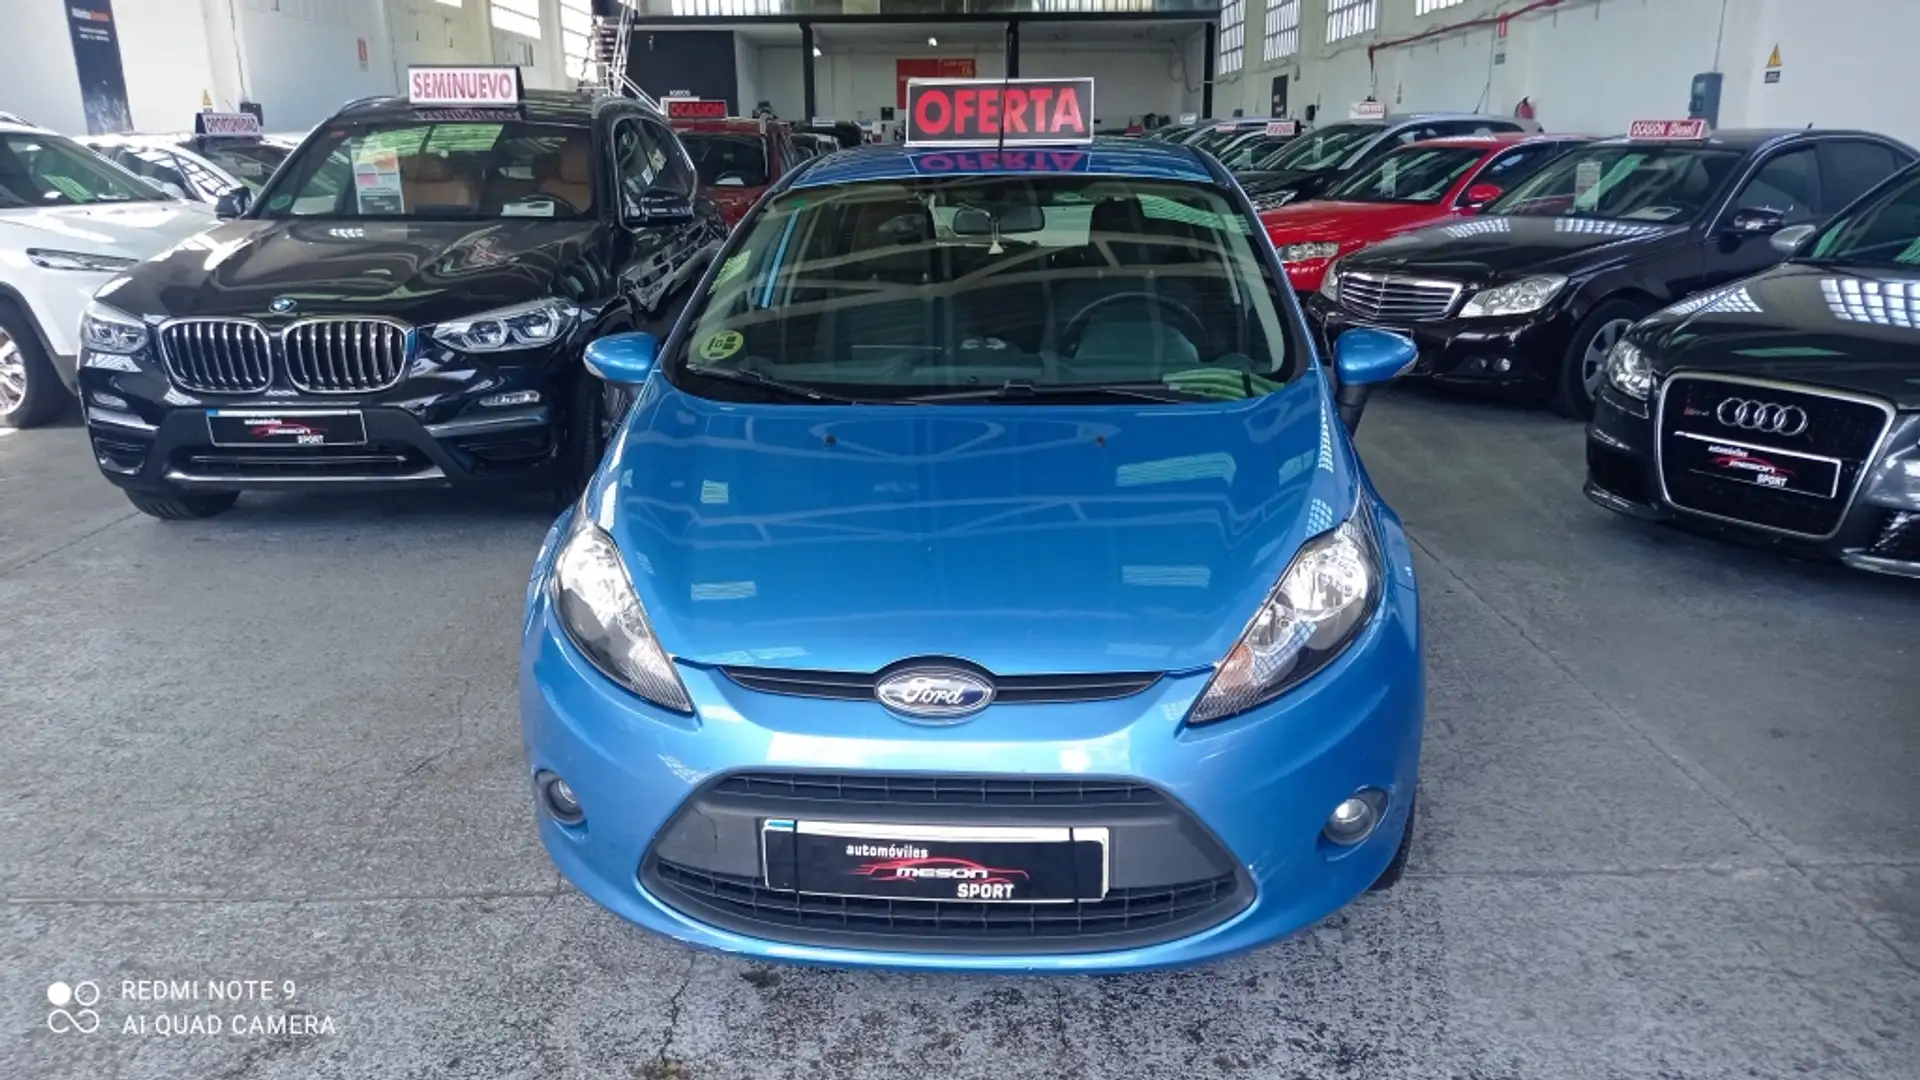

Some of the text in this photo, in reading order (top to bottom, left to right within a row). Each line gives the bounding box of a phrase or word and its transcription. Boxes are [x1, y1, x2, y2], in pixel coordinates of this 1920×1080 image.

[413, 73, 512, 98] SEMINUEVO
[671, 103, 725, 117] OCASION
[915, 88, 1084, 134] OFERTA
[1631, 121, 1667, 137] OCASION
[297, 434, 324, 444] SPORT
[1756, 473, 1788, 487] SPORT
[902, 677, 965, 705] Ford
[845, 843, 928, 859] automóviles
[957, 883, 1015, 899] SPORT
